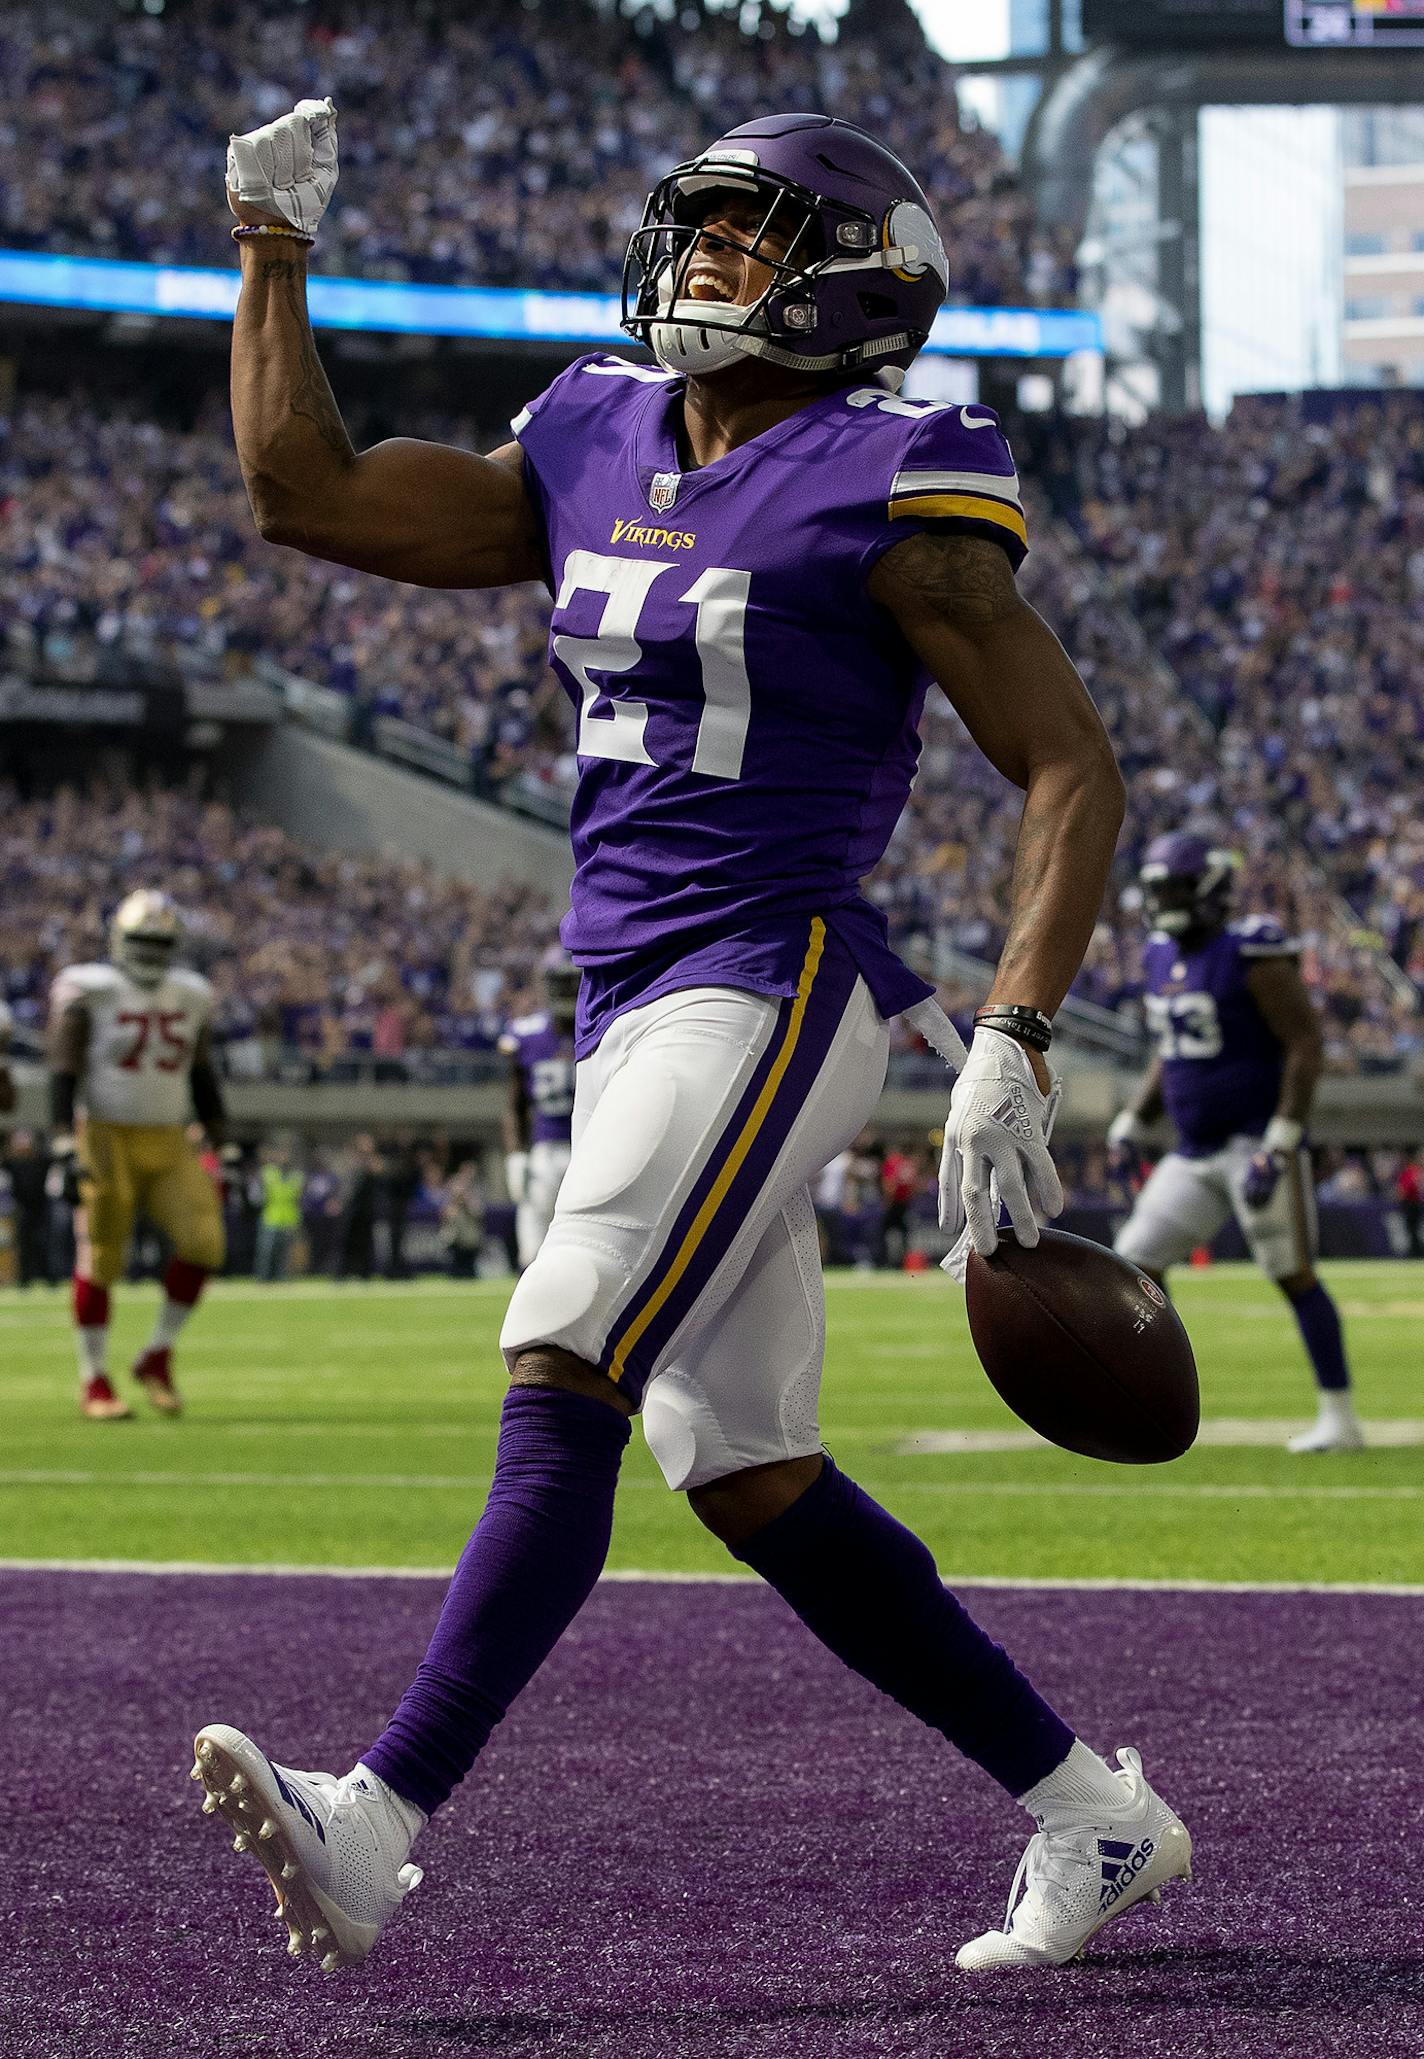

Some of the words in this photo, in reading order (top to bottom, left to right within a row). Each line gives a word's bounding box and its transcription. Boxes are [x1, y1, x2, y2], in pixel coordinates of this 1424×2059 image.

[653, 488, 671, 504] NFL
[552, 549, 752, 780] 21
[116, 1008, 187, 1072] 75
[1011, 1086, 1033, 1138] adidas
